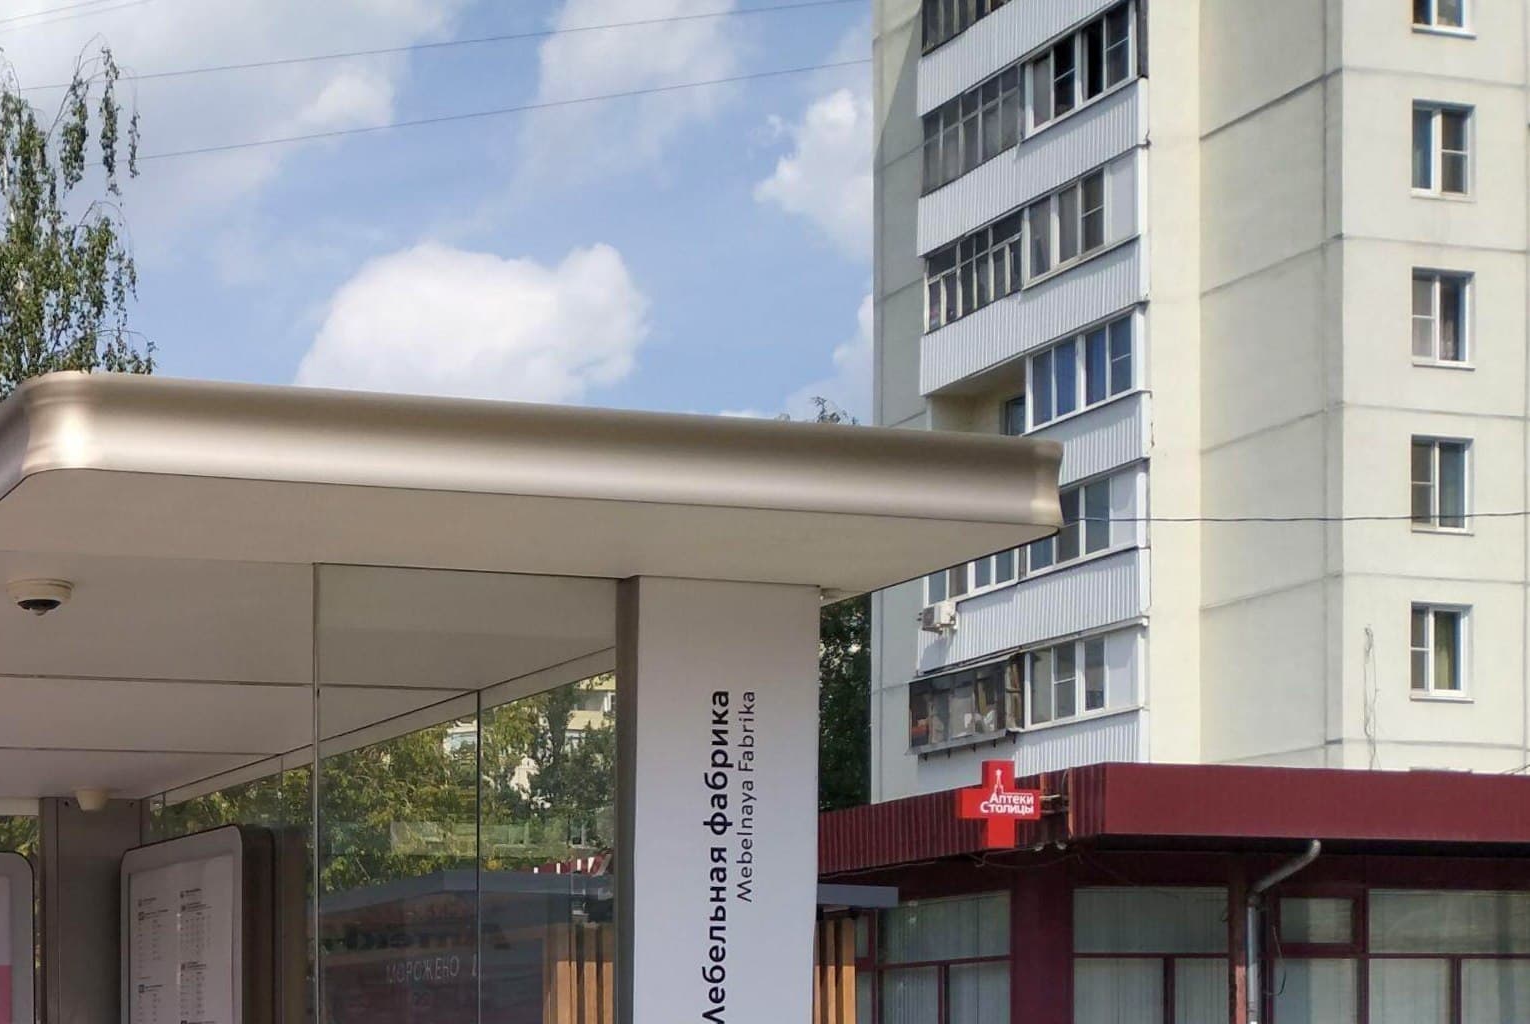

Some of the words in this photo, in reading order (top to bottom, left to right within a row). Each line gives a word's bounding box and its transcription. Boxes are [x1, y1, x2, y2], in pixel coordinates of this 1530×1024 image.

[703, 690, 734, 836] фабрика
[738, 691, 756, 772] Fabrika
[980, 801, 1034, 815] Столицы
[989, 792, 1034, 804] Аптеки
[736, 779, 757, 903] Mebelnaya
